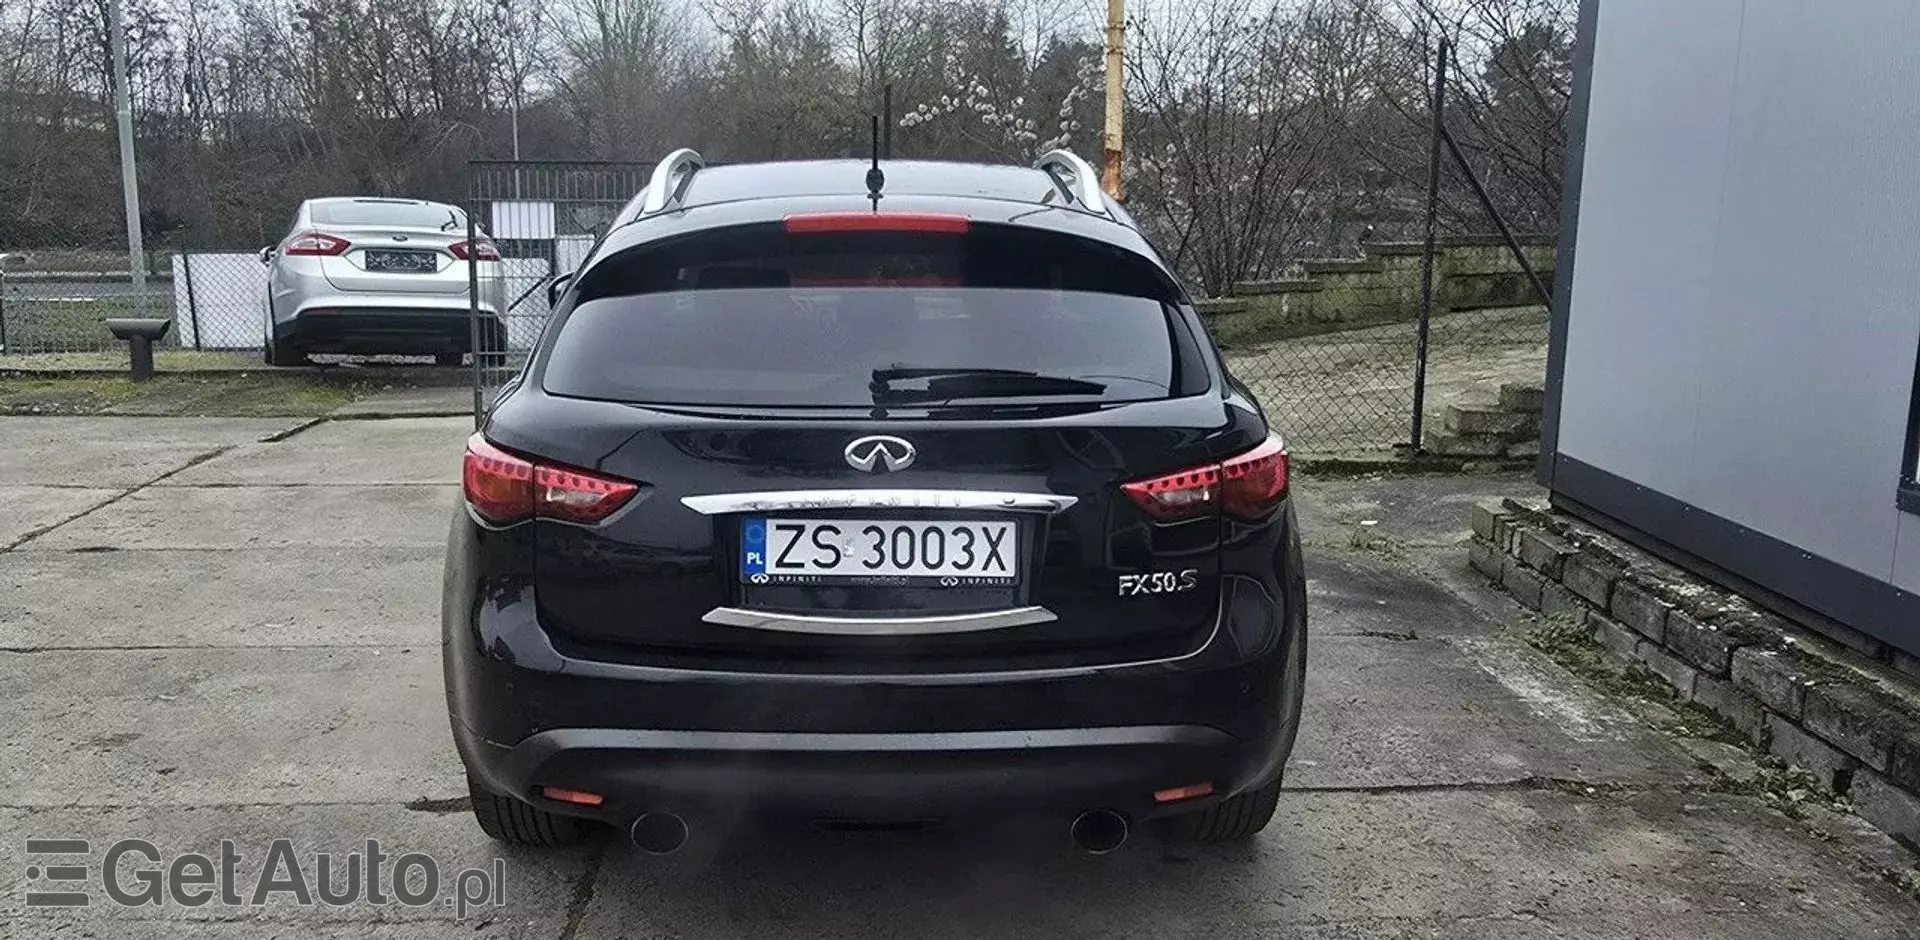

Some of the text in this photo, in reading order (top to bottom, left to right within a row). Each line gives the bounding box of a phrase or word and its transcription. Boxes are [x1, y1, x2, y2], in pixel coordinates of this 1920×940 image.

[747, 553, 763, 565] PL
[775, 524, 1007, 572] ZS 3003X
